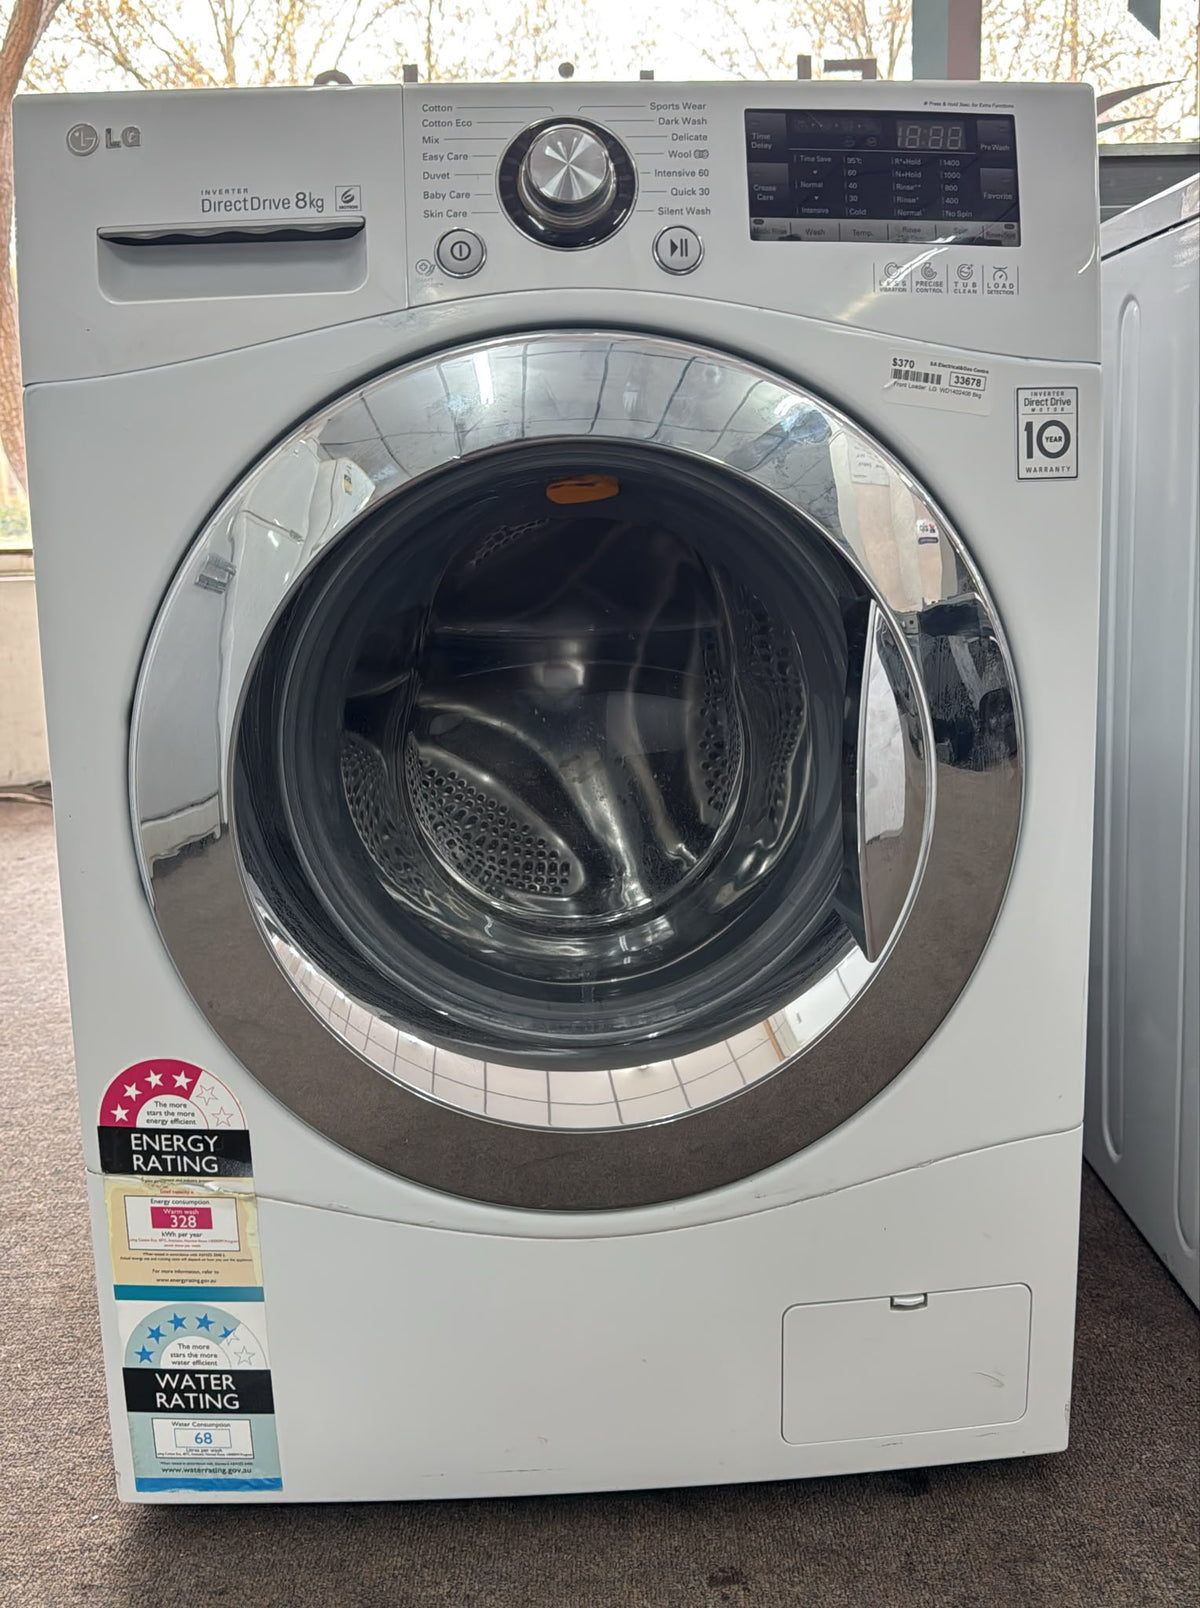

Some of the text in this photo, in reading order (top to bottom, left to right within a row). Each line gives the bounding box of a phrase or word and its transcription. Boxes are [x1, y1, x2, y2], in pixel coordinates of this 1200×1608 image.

[422, 103, 452, 112] Cotton
[650, 102, 707, 112] Sports Wear
[422, 118, 473, 128] Cotton Eco
[658, 116, 708, 126] Dark Wash
[105, 126, 141, 149] LG
[422, 135, 440, 144] Mix
[671, 132, 708, 142] Delicate
[752, 132, 771, 140] Time
[751, 142, 772, 150] Delay
[422, 152, 469, 162] Easy Care
[668, 150, 692, 159] Wool
[422, 171, 450, 180] Duvet
[654, 168, 710, 178] Intensive 60
[800, 180, 824, 188] Normal
[945, 184, 958, 192] 800
[200, 188, 249, 197] INVERTER
[423, 190, 471, 200] Baby Care
[671, 187, 710, 197] Quick 30
[984, 192, 1013, 200] Favorite
[423, 208, 468, 218] Skin Care
[658, 206, 712, 216] Silent Wash
[849, 208, 867, 216] Cold
[946, 210, 972, 219] No Spin
[806, 228, 826, 236] Wash
[902, 226, 922, 234] Rinse
[916, 280, 944, 288] PRECISE
[987, 282, 1014, 290] LOAD
[892, 357, 915, 369] $370
[954, 375, 982, 388] 33678
[1024, 398, 1072, 407] Direct Drive
[1024, 420, 1071, 460] 10
[1026, 466, 1071, 474] WARRANTY
[154, 1100, 168, 1108] The
[146, 1118, 168, 1126] energy
[130, 1132, 219, 1153] ENERGY
[132, 1155, 218, 1174] RATING
[150, 1198, 210, 1207] Energy consumption
[170, 1215, 197, 1228] 328
[155, 1373, 236, 1390] WATER
[156, 1392, 240, 1410] RATING
[194, 1432, 213, 1445] 68
[162, 1467, 252, 1476] www.waterrating.gov.au
